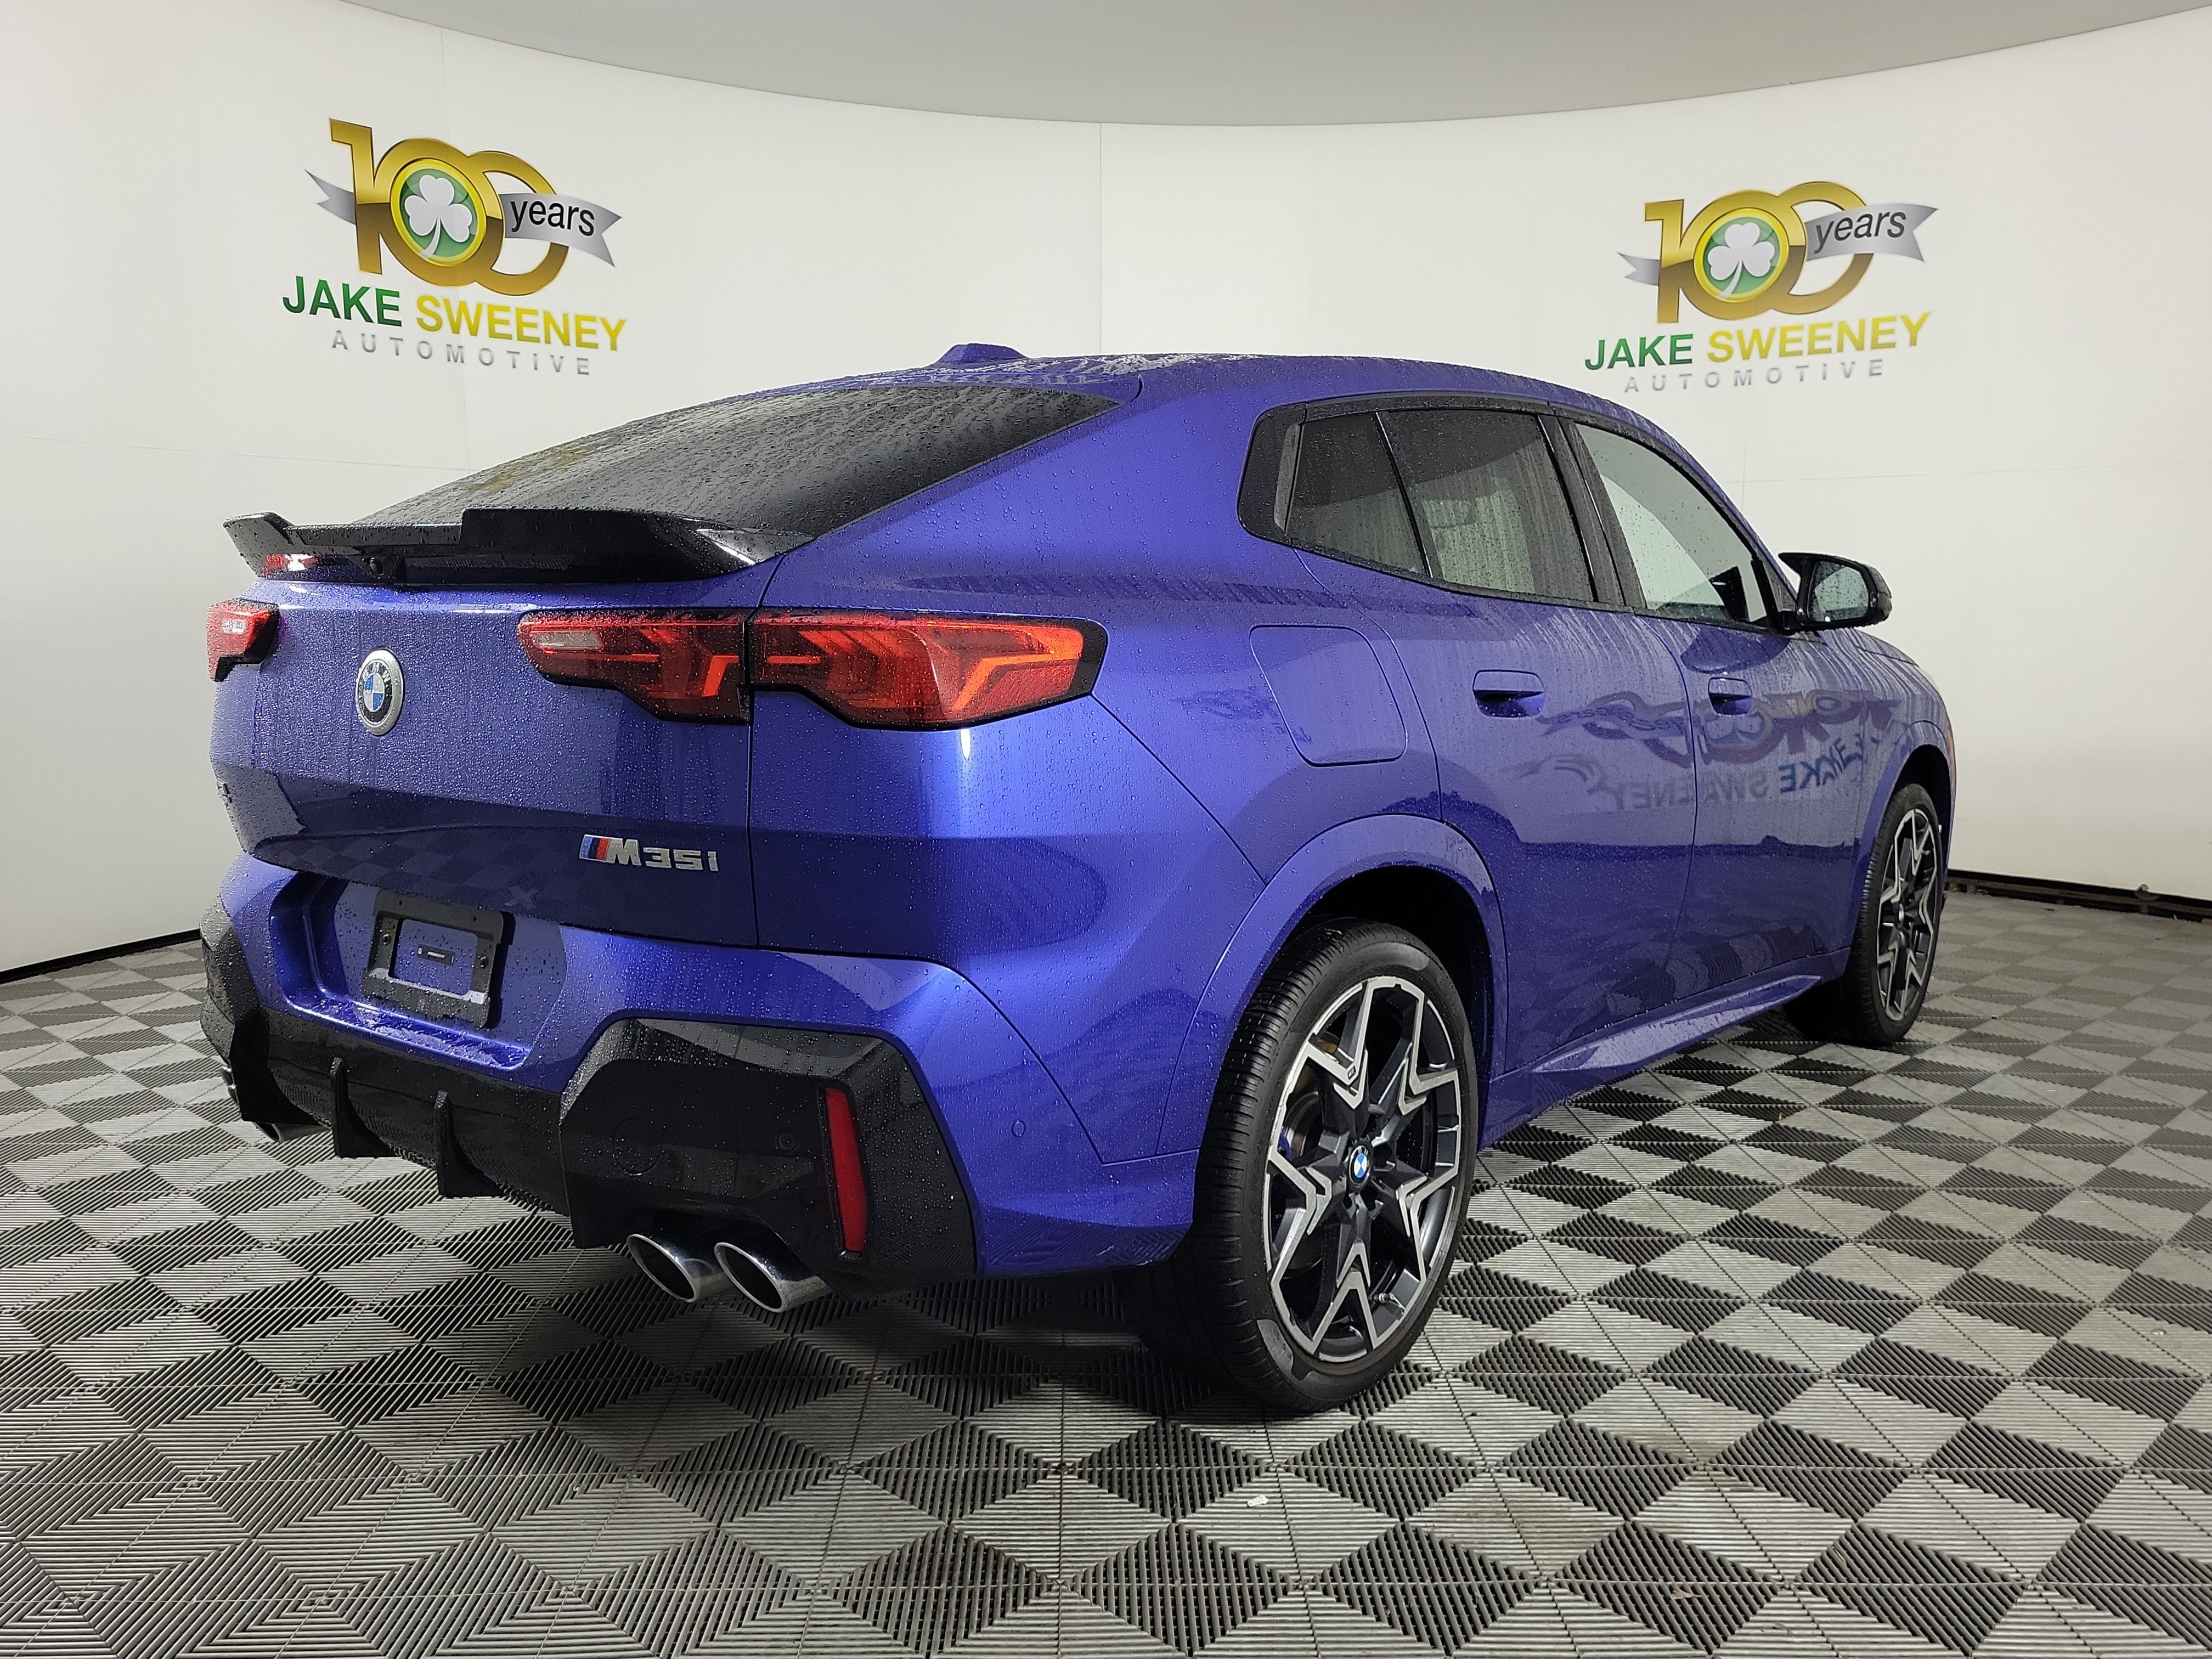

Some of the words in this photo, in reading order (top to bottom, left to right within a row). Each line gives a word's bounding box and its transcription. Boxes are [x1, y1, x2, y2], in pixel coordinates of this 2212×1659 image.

[329, 117, 569, 296] 100
[511, 200, 595, 236] years
[1645, 181, 1875, 324] 100
[1815, 208, 1906, 254] years
[282, 275, 402, 328] JAKE
[415, 294, 627, 351] SWEENEY
[331, 329, 590, 376] AUTOMOTIVE
[1584, 332, 1694, 371] JAKE
[1706, 312, 1931, 363] SWEENEY
[1624, 358, 1884, 394] AUTOMOTIVE
[362, 662, 391, 683] BMW
[603, 837, 719, 872] M35i
